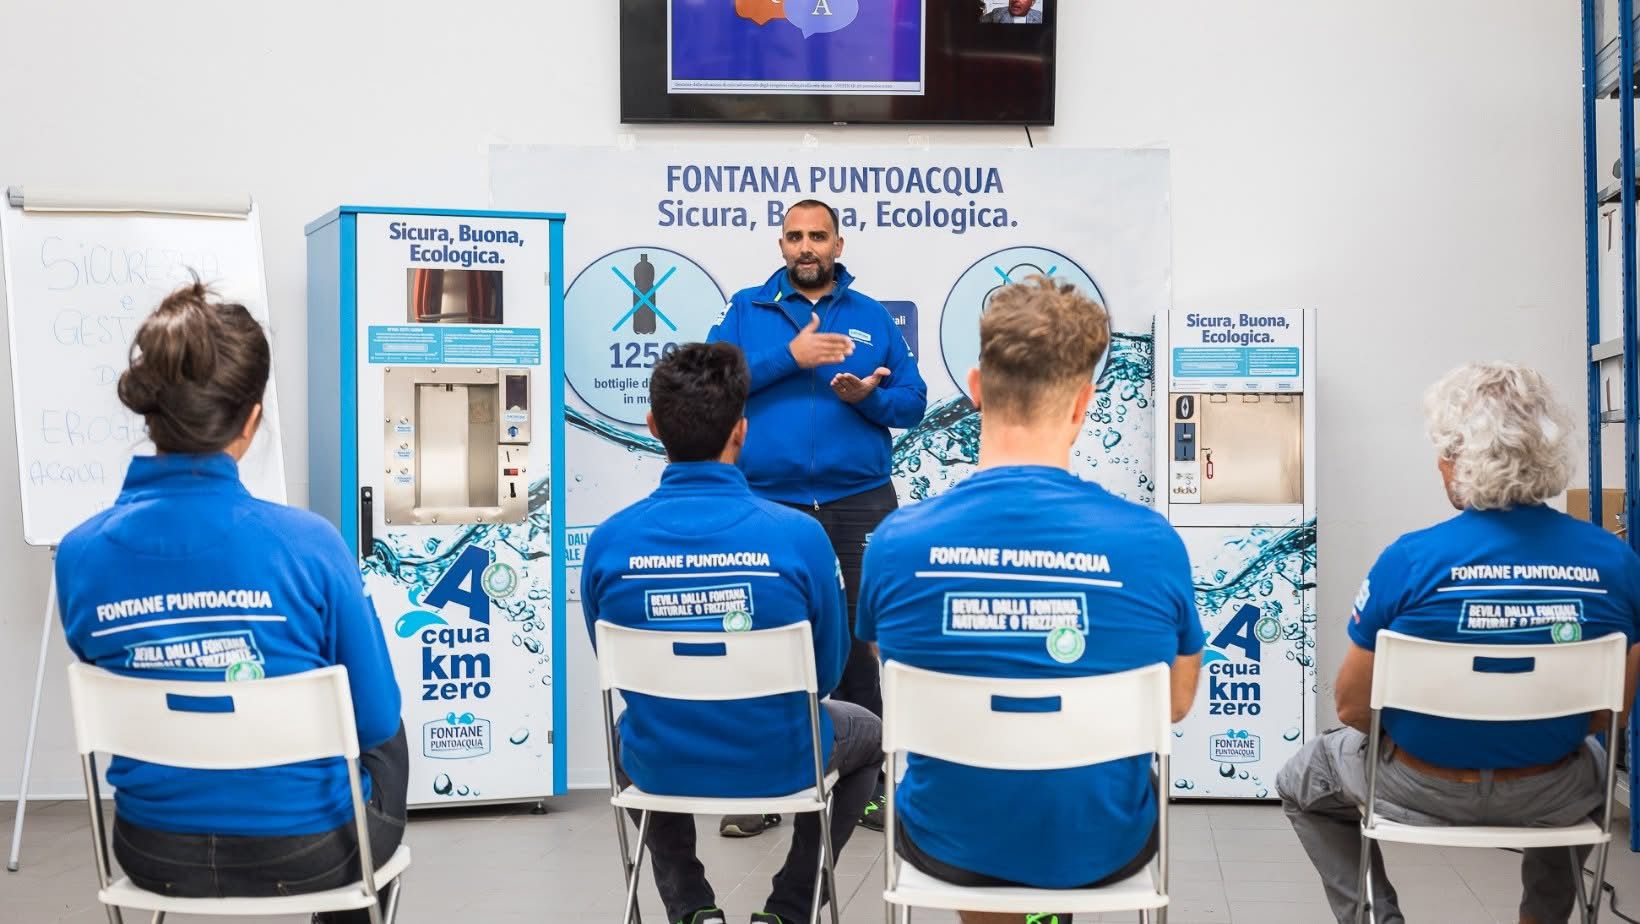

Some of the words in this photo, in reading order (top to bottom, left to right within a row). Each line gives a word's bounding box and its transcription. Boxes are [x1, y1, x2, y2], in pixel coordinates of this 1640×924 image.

[667, 165, 800, 193] FONTANA
[810, 166, 1004, 197] PUNTOACQUA
[658, 200, 757, 231] Sicura,
[876, 202, 1018, 234] Ecologica.
[389, 222, 454, 244] Sicura,
[458, 224, 524, 246] Buona,
[410, 244, 505, 267] Ecologica.
[1186, 313, 1236, 329] Sicura,
[1239, 313, 1290, 329] Buona,
[1202, 329, 1275, 346] Ecologica.
[594, 378, 639, 391] bottiglie
[624, 393, 634, 404] in
[629, 554, 684, 569] FONTANE
[685, 552, 770, 568] PUNTOACQUA
[930, 547, 999, 567] FONTANE
[1002, 549, 1111, 573] PUNTOACQUA
[1451, 565, 1511, 581] FONTANE
[1513, 565, 1600, 582] PUNTOACQUA
[423, 544, 490, 626] A
[651, 593, 679, 606] BEVILA
[681, 591, 708, 604] DALLA
[709, 588, 749, 602] FONTANA.
[96, 595, 165, 622] FONTANE
[167, 590, 273, 611] PUNTOACQUA
[652, 604, 693, 616] NATURALE
[695, 604, 702, 615] O
[1469, 604, 1501, 617] BEVILA
[1009, 615, 1019, 630] O
[421, 626, 490, 649] cqua
[1211, 603, 1261, 663] A
[422, 647, 491, 681] km
[1209, 663, 1260, 678] cqua
[422, 681, 491, 701] zero
[1209, 676, 1261, 700] km
[1209, 702, 1261, 716] zero
[430, 725, 483, 740] FONTANE
[430, 738, 483, 750] PUNTOACQUA
[1215, 739, 1255, 749] FONTANE
